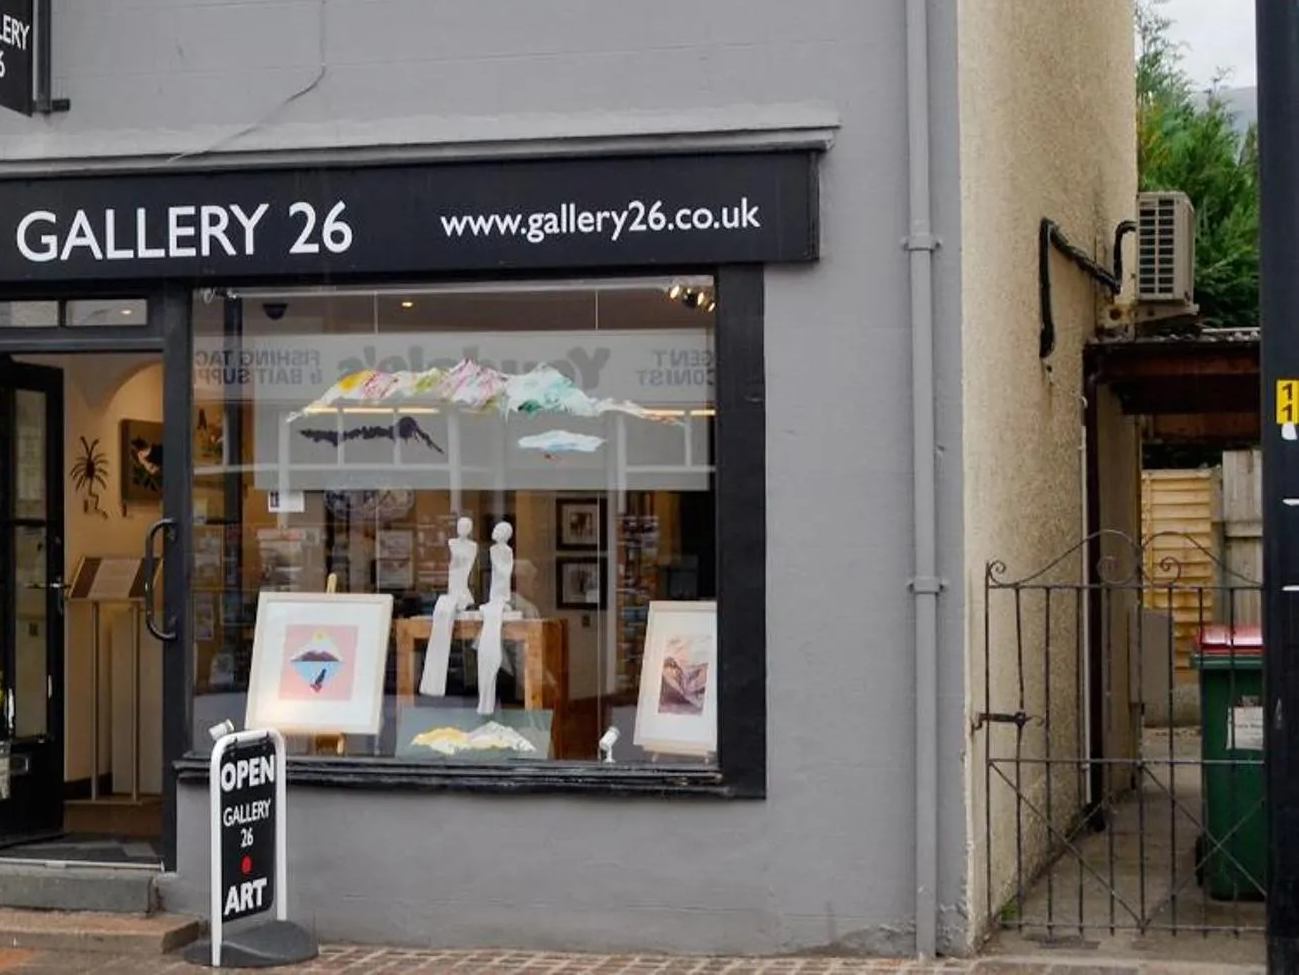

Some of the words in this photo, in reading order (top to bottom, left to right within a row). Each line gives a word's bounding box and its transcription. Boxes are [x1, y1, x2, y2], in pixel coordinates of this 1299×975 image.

[16, 203, 269, 262] GALLERY
[289, 200, 353, 254] 26
[440, 197, 760, 243] www.gallery26.co.uk
[221, 755, 275, 793] OPEN
[223, 799, 271, 827] GALLERY
[240, 827, 253, 848] 26
[223, 877, 268, 917] ART
